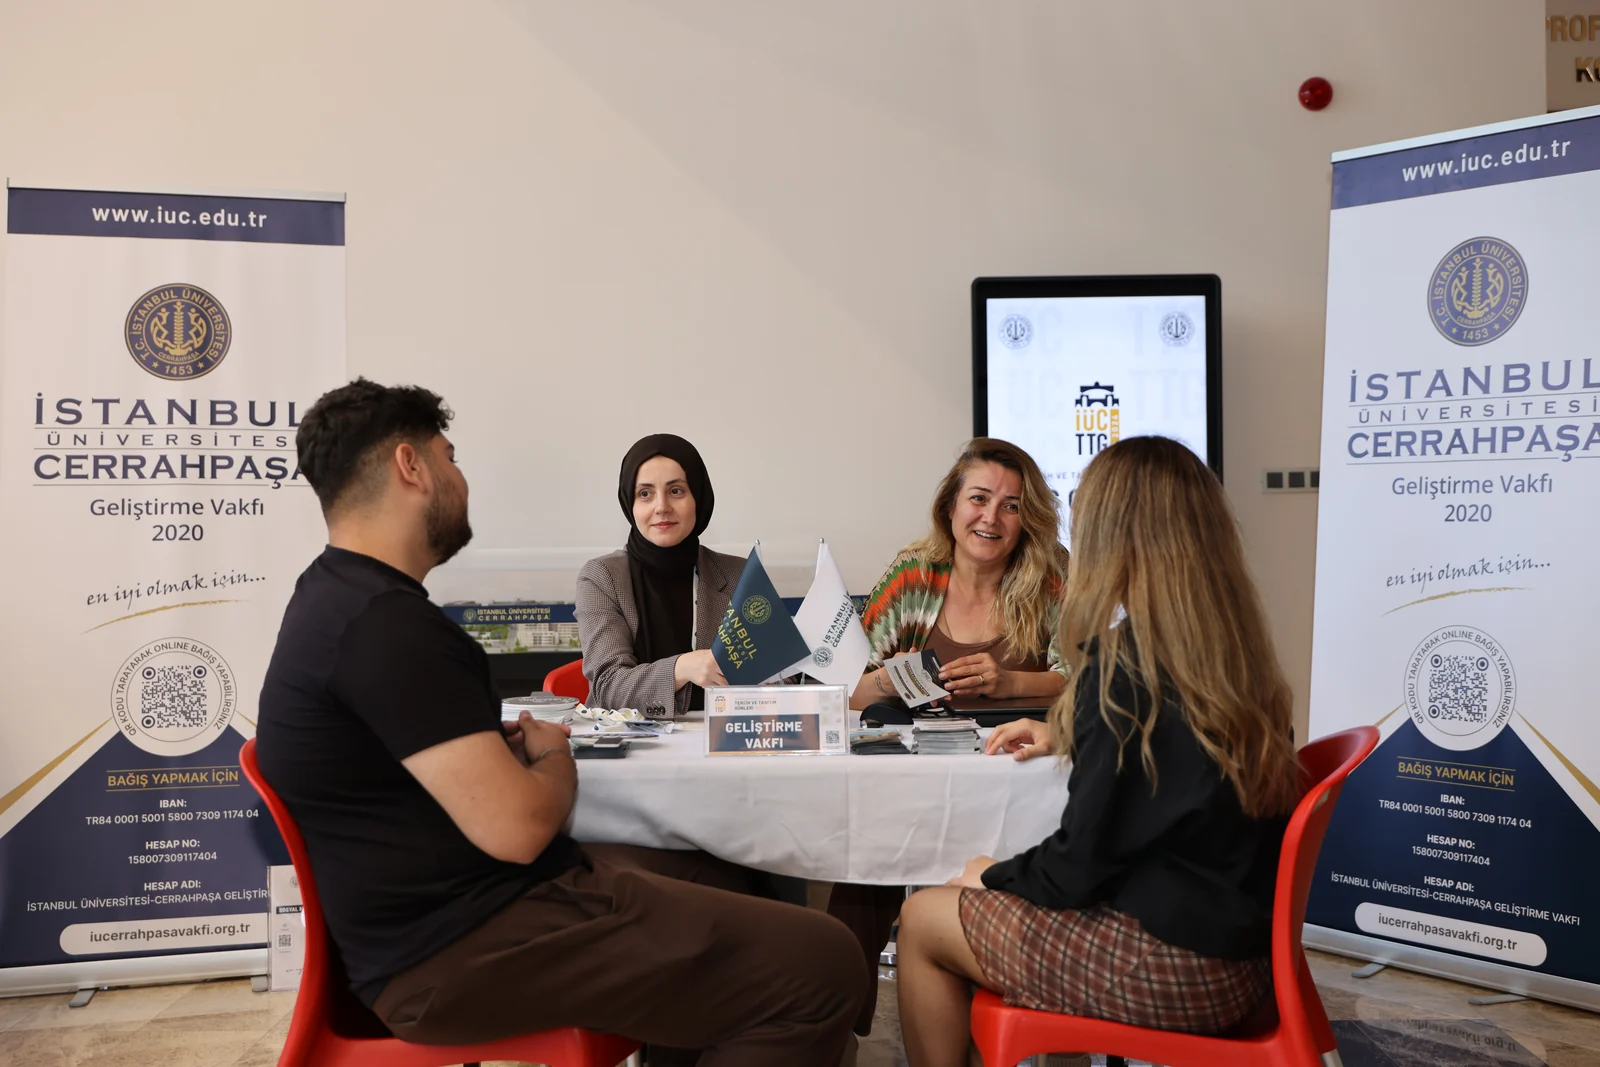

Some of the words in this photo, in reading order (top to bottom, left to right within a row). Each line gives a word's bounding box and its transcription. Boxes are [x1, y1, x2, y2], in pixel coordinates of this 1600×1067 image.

[1402, 139, 1571, 182] www.iuc.edu.tr
[92, 205, 267, 228] www.iuc.edu.tr
[1432, 245, 1477, 300] İSTANBUL
[1481, 241, 1525, 322] ÜNİVERSİTESİ
[129, 289, 178, 335] İSTANBUL
[1436, 302, 1450, 327] T.C.
[182, 287, 228, 364] ÜNİVERSİTESİ
[1462, 327, 1489, 340] 1453
[135, 338, 150, 360] T.C.
[165, 365, 193, 375] 1453
[1349, 358, 1600, 403] İSTANBUL
[34, 392, 301, 427] İSTANBUL
[1358, 395, 1598, 424] ÜNİVERSİTESİ
[47, 431, 288, 448] ÜNİVERSİTES
[1075, 433, 1108, 455] TTG
[1347, 422, 1600, 462] CERRAHPAŞA
[1392, 475, 1494, 500] Geliştirme
[1500, 473, 1553, 494] Vakfı
[90, 498, 204, 520] Geliştirme
[211, 498, 264, 515] Vakfı
[1444, 503, 1493, 522] 2020
[152, 524, 203, 541] 2020
[1386, 576, 1406, 588] en
[1410, 566, 1434, 594] iyi
[1438, 557, 1494, 581] olmak
[86, 591, 109, 606] en
[114, 586, 142, 610] iyi
[147, 573, 208, 597] olmak
[478, 614, 549, 622] CERRAHPAŞA
[154, 641, 189, 652] ONLINE
[1441, 630, 1473, 641] ONLINE
[1474, 634, 1500, 657] BAĞIŞ
[190, 642, 217, 665] BAĞIŞ
[1408, 635, 1441, 681] TARATARAK
[116, 648, 153, 694] TARATARAK
[214, 663, 235, 731] YAPABİLİRSİNİZ
[1407, 682, 1420, 711] KODU
[1492, 655, 1514, 729] YAPABİLİRSİNİZ
[115, 696, 132, 723] KODU
[725, 719, 802, 735] GELİŞTİRME
[744, 737, 783, 749] VAKFI
[107, 772, 149, 787] BAĞIŞ
[152, 770, 208, 785] YAPMAK
[211, 768, 239, 783] İÇİN
[1398, 761, 1432, 778] BAĞIŞ
[1435, 766, 1486, 783] YAPMAK
[1488, 770, 1515, 787] İÇİN
[159, 798, 187, 809] IBAN:
[1440, 793, 1465, 806] IBAN:
[86, 815, 112, 826] TR84
[114, 813, 139, 824] 0001
[141, 812, 165, 823] 5001
[168, 811, 193, 822] 5800
[196, 810, 221, 821] 7309
[222, 809, 243, 820] 1174
[246, 808, 259, 819] 04
[1379, 799, 1401, 811] TR84
[1402, 802, 1423, 814] 0001
[1424, 806, 1445, 818] 5001
[1447, 809, 1471, 821] 5800
[1472, 812, 1495, 824] 7309
[1497, 815, 1517, 827] 1174
[1519, 818, 1532, 829] 04
[145, 839, 179, 850] HESAP
[182, 838, 200, 849] NO:
[1426, 833, 1457, 847] HESAP
[1458, 838, 1476, 850] NO:
[128, 851, 217, 865] 158007309117404
[1411, 845, 1490, 867] 158007309117404
[144, 880, 178, 891] HESAP
[180, 879, 202, 890] ADI:
[1424, 875, 1454, 888] HESAP
[1455, 880, 1475, 893] ADI:
[27, 899, 78, 912] İSTANBUL
[80, 890, 222, 909] ÜNİVERSİTESİ-CERRAHPAŞA
[224, 887, 271, 903] GELİŞTİR
[1331, 870, 1370, 889] İSTANBUL
[1372, 878, 1492, 911] ÜNİVERSİTESİ-CERRAHPAŞA
[1494, 902, 1550, 921] GELİŞTİRME
[1551, 911, 1581, 927] VAKFI
[90, 922, 251, 944] iucerrahpasavakfi.org.tr
[1378, 912, 1518, 951] iucerrahpasavakfi.org.tr
